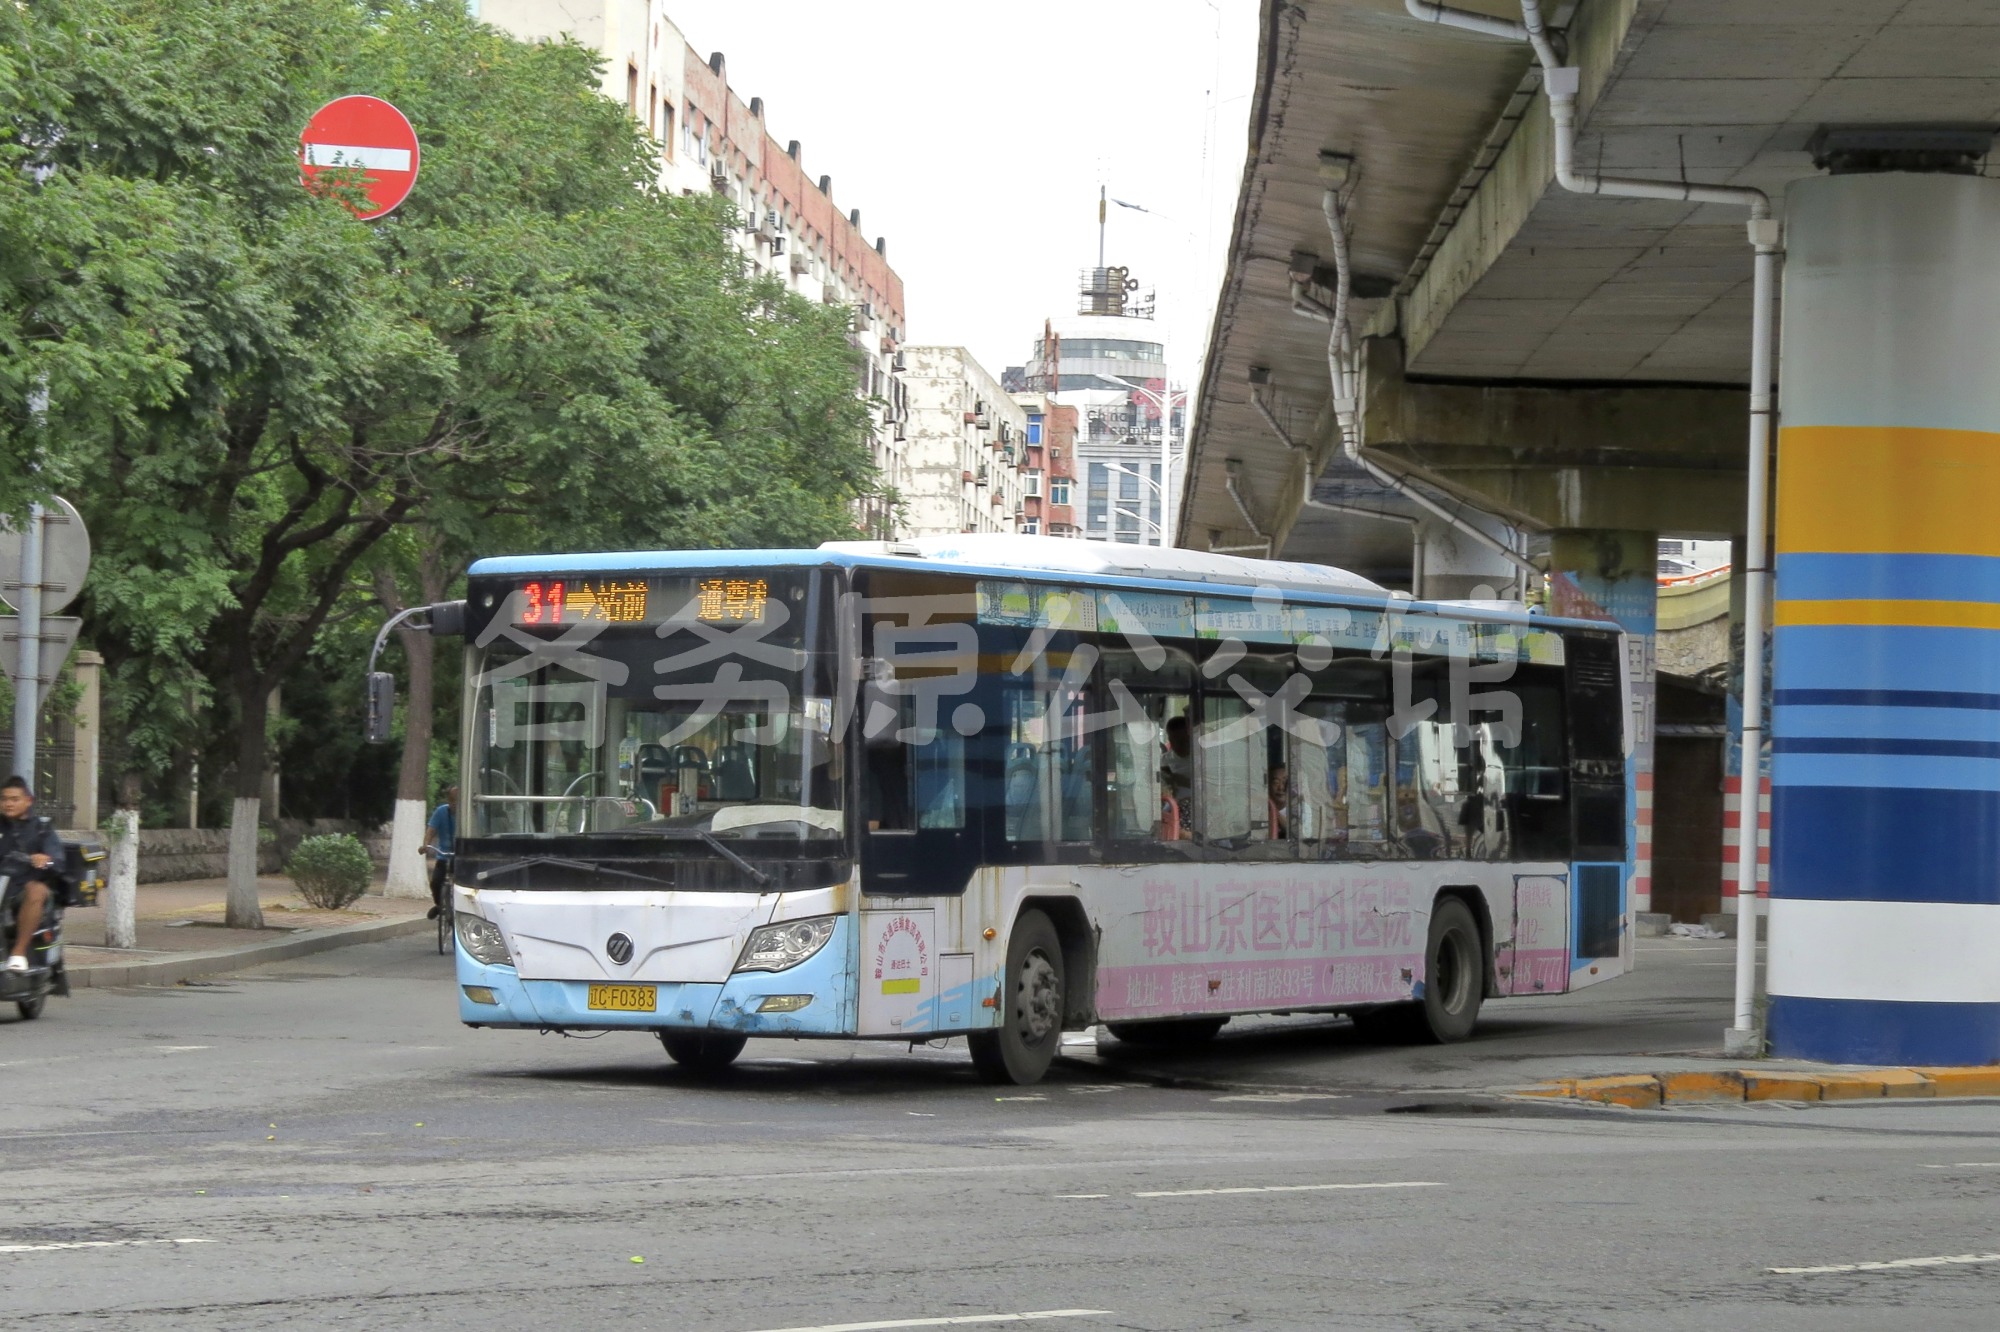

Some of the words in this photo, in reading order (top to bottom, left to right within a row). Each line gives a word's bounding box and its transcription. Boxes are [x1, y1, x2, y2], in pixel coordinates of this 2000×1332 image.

[522, 582, 563, 622] 31
[595, 582, 649, 621] 站前
[1143, 875, 1411, 957] 鞍山京医妇科医院
[1536, 956, 1564, 984] 7777
